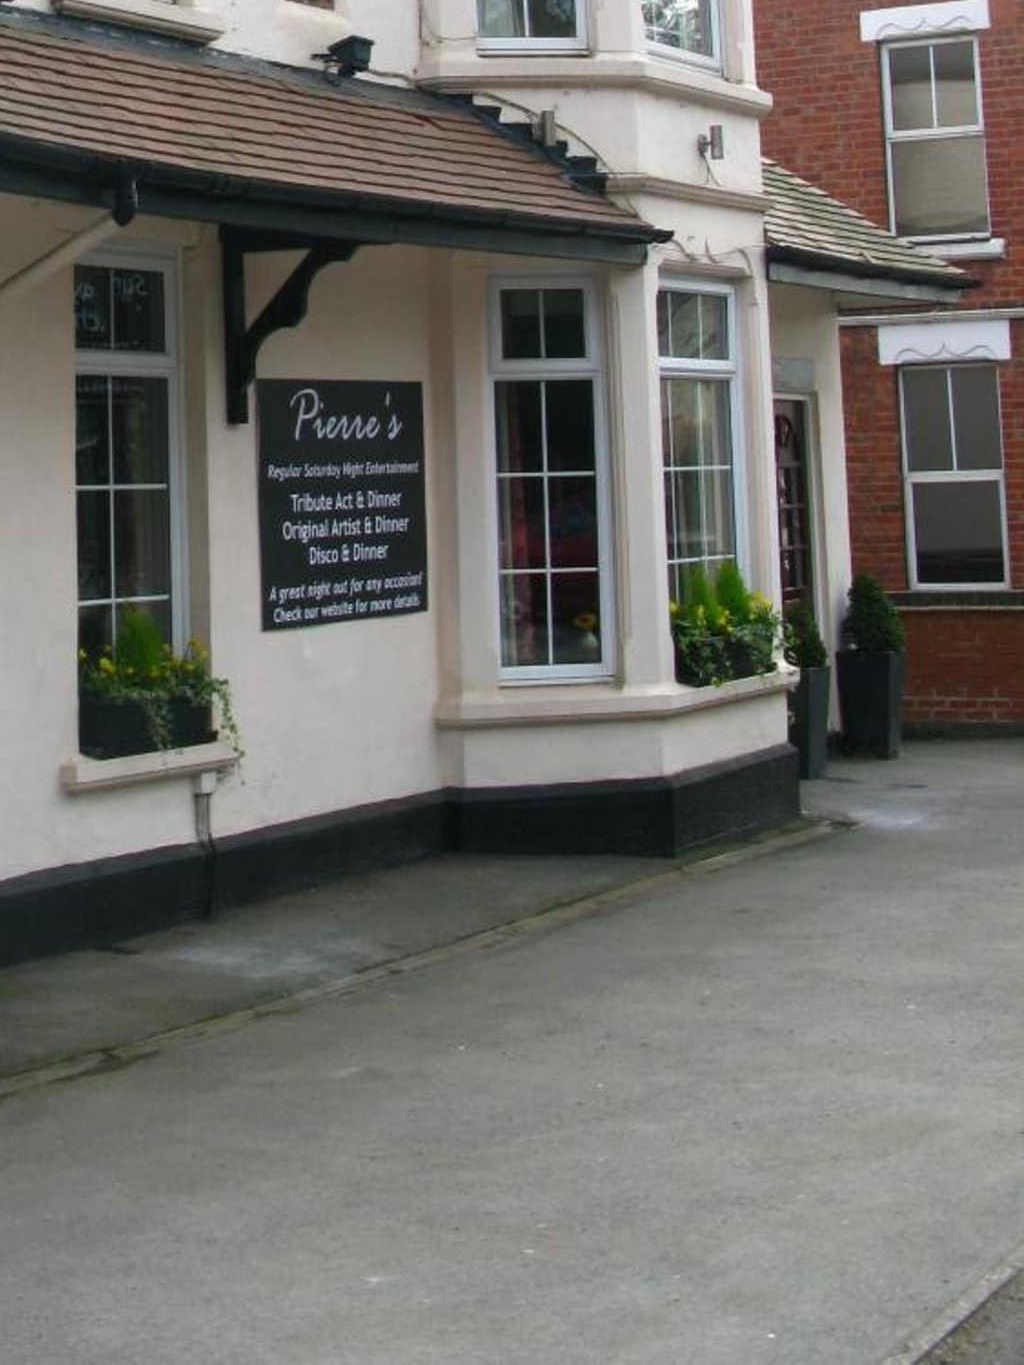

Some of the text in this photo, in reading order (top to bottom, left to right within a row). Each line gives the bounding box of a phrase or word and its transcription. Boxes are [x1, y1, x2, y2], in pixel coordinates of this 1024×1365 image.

[290, 388, 402, 440] Pierre's
[268, 461, 419, 482] Regular Saturday Night Entertainment
[289, 490, 402, 512] Tribute Act & Dinner
[282, 515, 410, 543] Original Artist & Dinner
[309, 543, 389, 566] Disco & Dinner
[269, 587, 277, 601] A
[278, 585, 305, 604] great
[307, 582, 331, 600] night
[333, 581, 348, 594] out
[350, 577, 364, 595] for
[366, 578, 382, 593] any
[273, 607, 302, 623] Check
[304, 607, 319, 619] our
[321, 602, 353, 616] website
[355, 599, 368, 612] for
[370, 598, 392, 611] more
